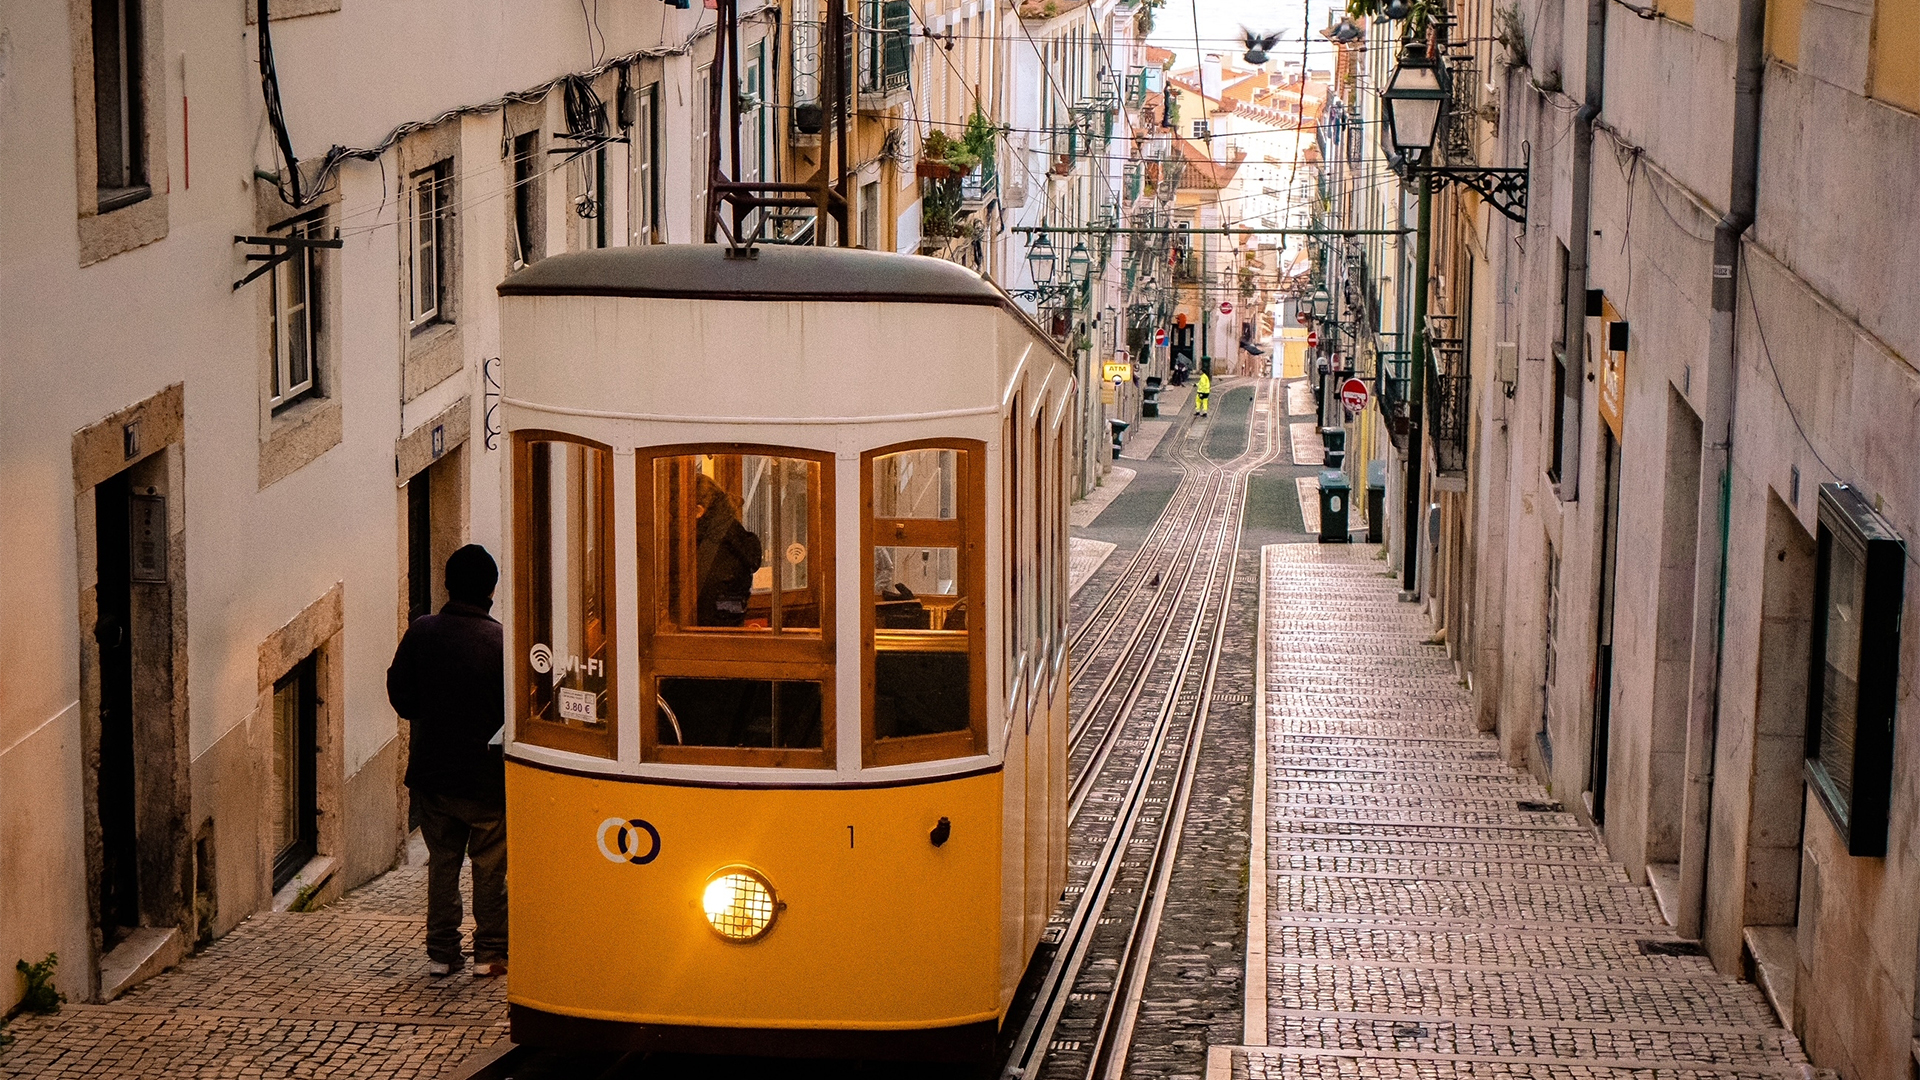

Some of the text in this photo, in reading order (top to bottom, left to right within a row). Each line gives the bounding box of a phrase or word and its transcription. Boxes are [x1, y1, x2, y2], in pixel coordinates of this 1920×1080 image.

[565, 700, 591, 715] 3.80 €
[846, 825, 855, 849] 1
